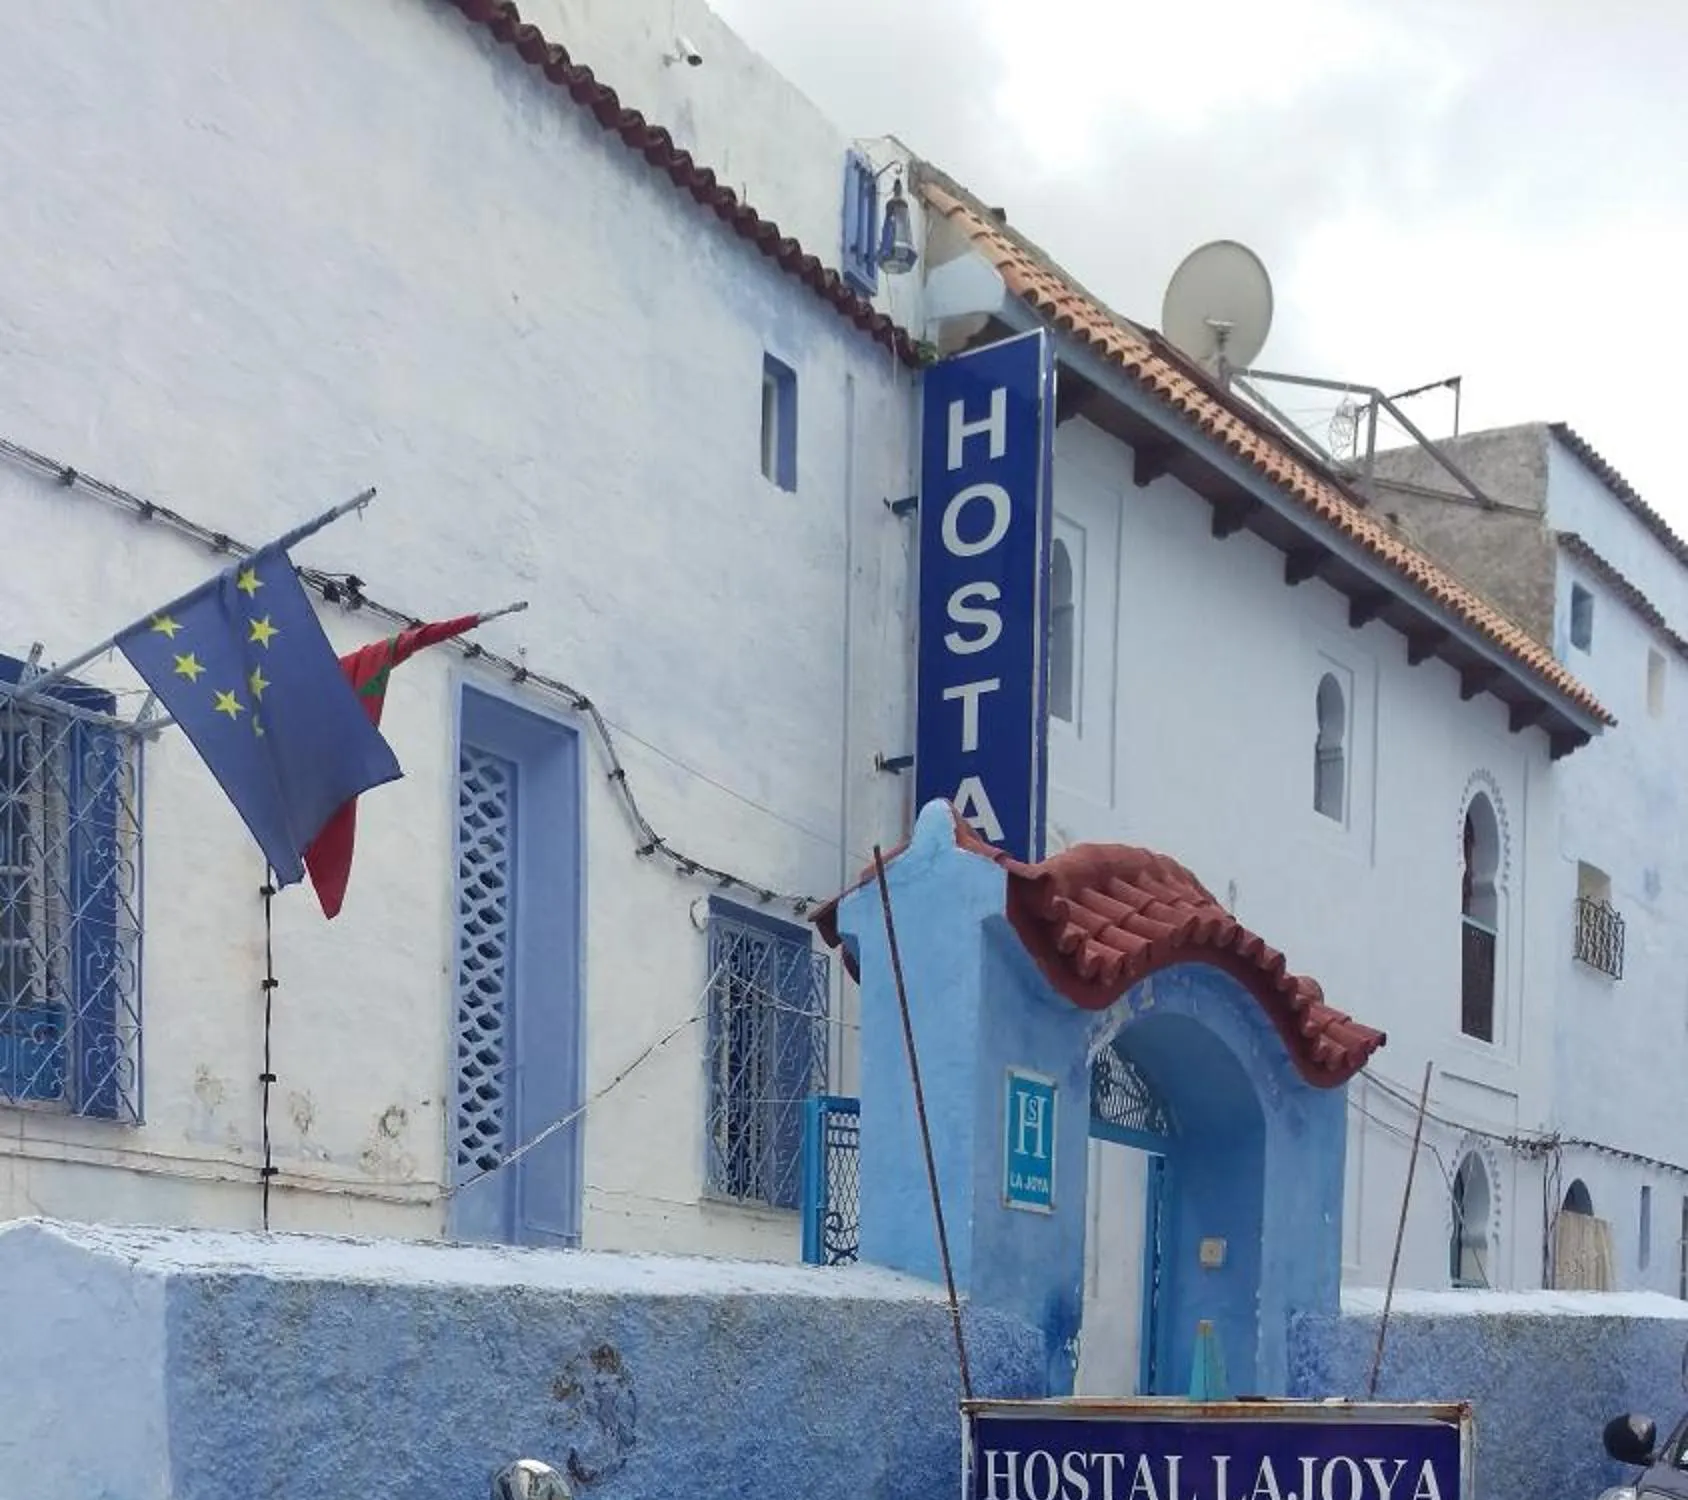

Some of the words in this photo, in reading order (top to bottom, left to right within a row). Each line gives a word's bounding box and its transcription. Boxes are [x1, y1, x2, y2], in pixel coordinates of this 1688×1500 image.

[942, 387, 1012, 841] HOSTA
[1010, 1171, 1023, 1189] LA
[1024, 1175, 1049, 1193] JOYA
